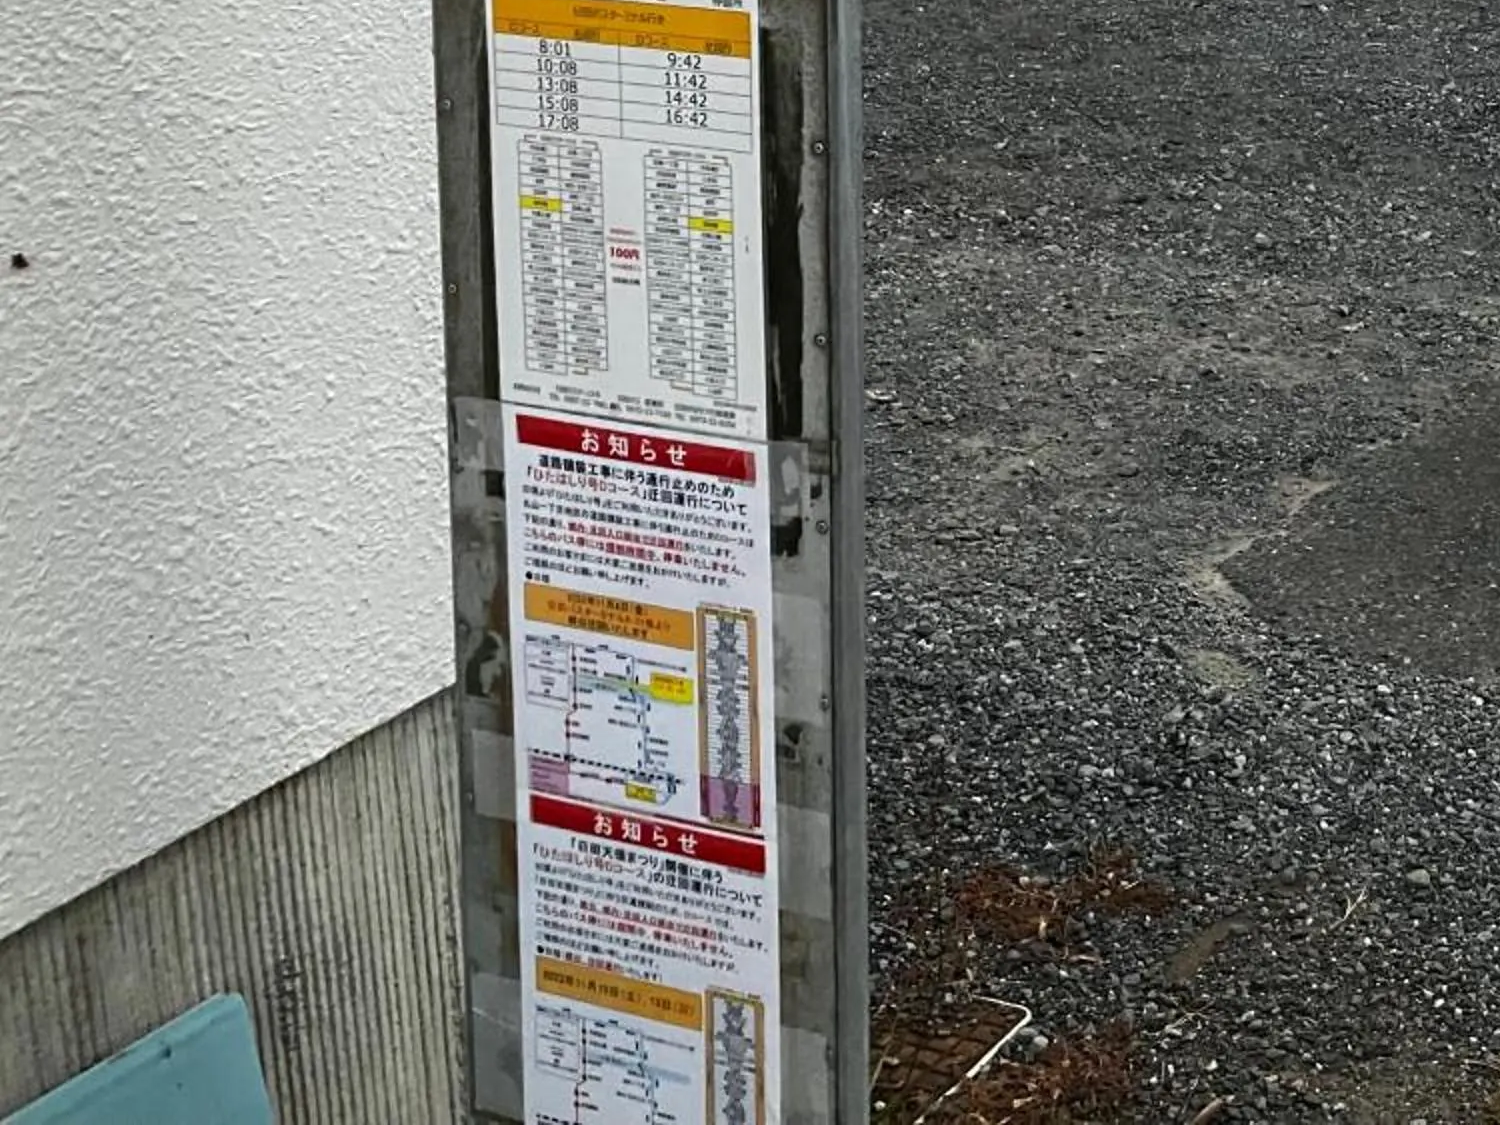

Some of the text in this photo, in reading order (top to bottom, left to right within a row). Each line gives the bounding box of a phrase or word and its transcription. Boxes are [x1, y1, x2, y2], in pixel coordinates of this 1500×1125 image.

[539, 40, 571, 56] 8:01
[536, 59, 577, 75] 10:08
[667, 53, 702, 70] 9:42
[537, 77, 577, 94] 13:08
[665, 72, 708, 89] 11:42
[538, 95, 578, 112] 15:08
[666, 91, 708, 108] 14:42
[538, 114, 579, 131] 17:08
[666, 109, 708, 126] 16:42
[581, 429, 687, 465] お知らせ
[594, 813, 699, 854] お知らせ
